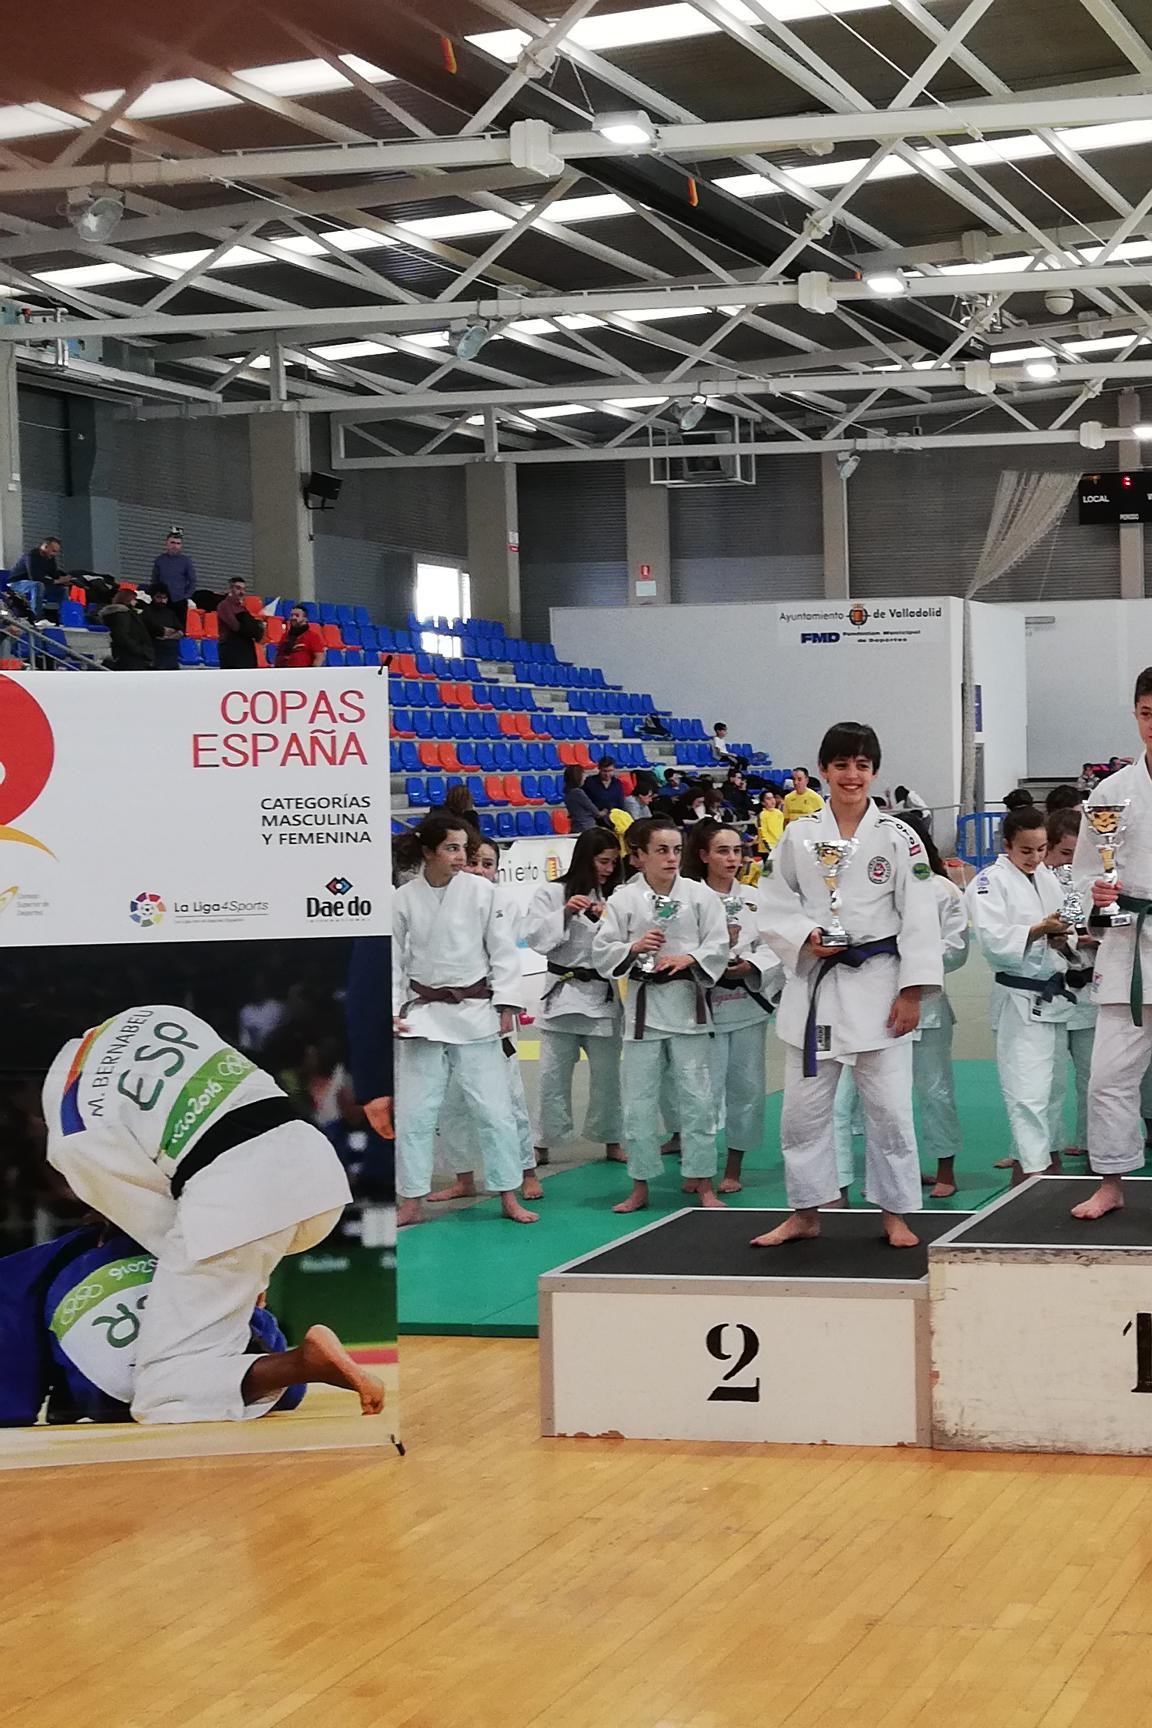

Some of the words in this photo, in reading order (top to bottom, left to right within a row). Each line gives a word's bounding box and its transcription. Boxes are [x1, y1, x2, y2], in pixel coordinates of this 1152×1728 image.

[1082, 494, 1110, 503] LOCAL
[873, 608, 886, 619] de
[889, 608, 942, 618] Valladolid
[801, 632, 841, 644] FMD
[220, 690, 366, 725] COPAS
[192, 728, 368, 769] ESPAÑA
[261, 793, 371, 811] CATEGORÍAS
[261, 812, 368, 828] MASCULINA
[262, 832, 273, 846] Y
[279, 831, 372, 845] FEMENINA
[174, 902, 189, 912] La
[92, 1010, 155, 1089] BERNABEU
[117, 1021, 199, 1112] ESP
[704, 1323, 761, 1402] 2
